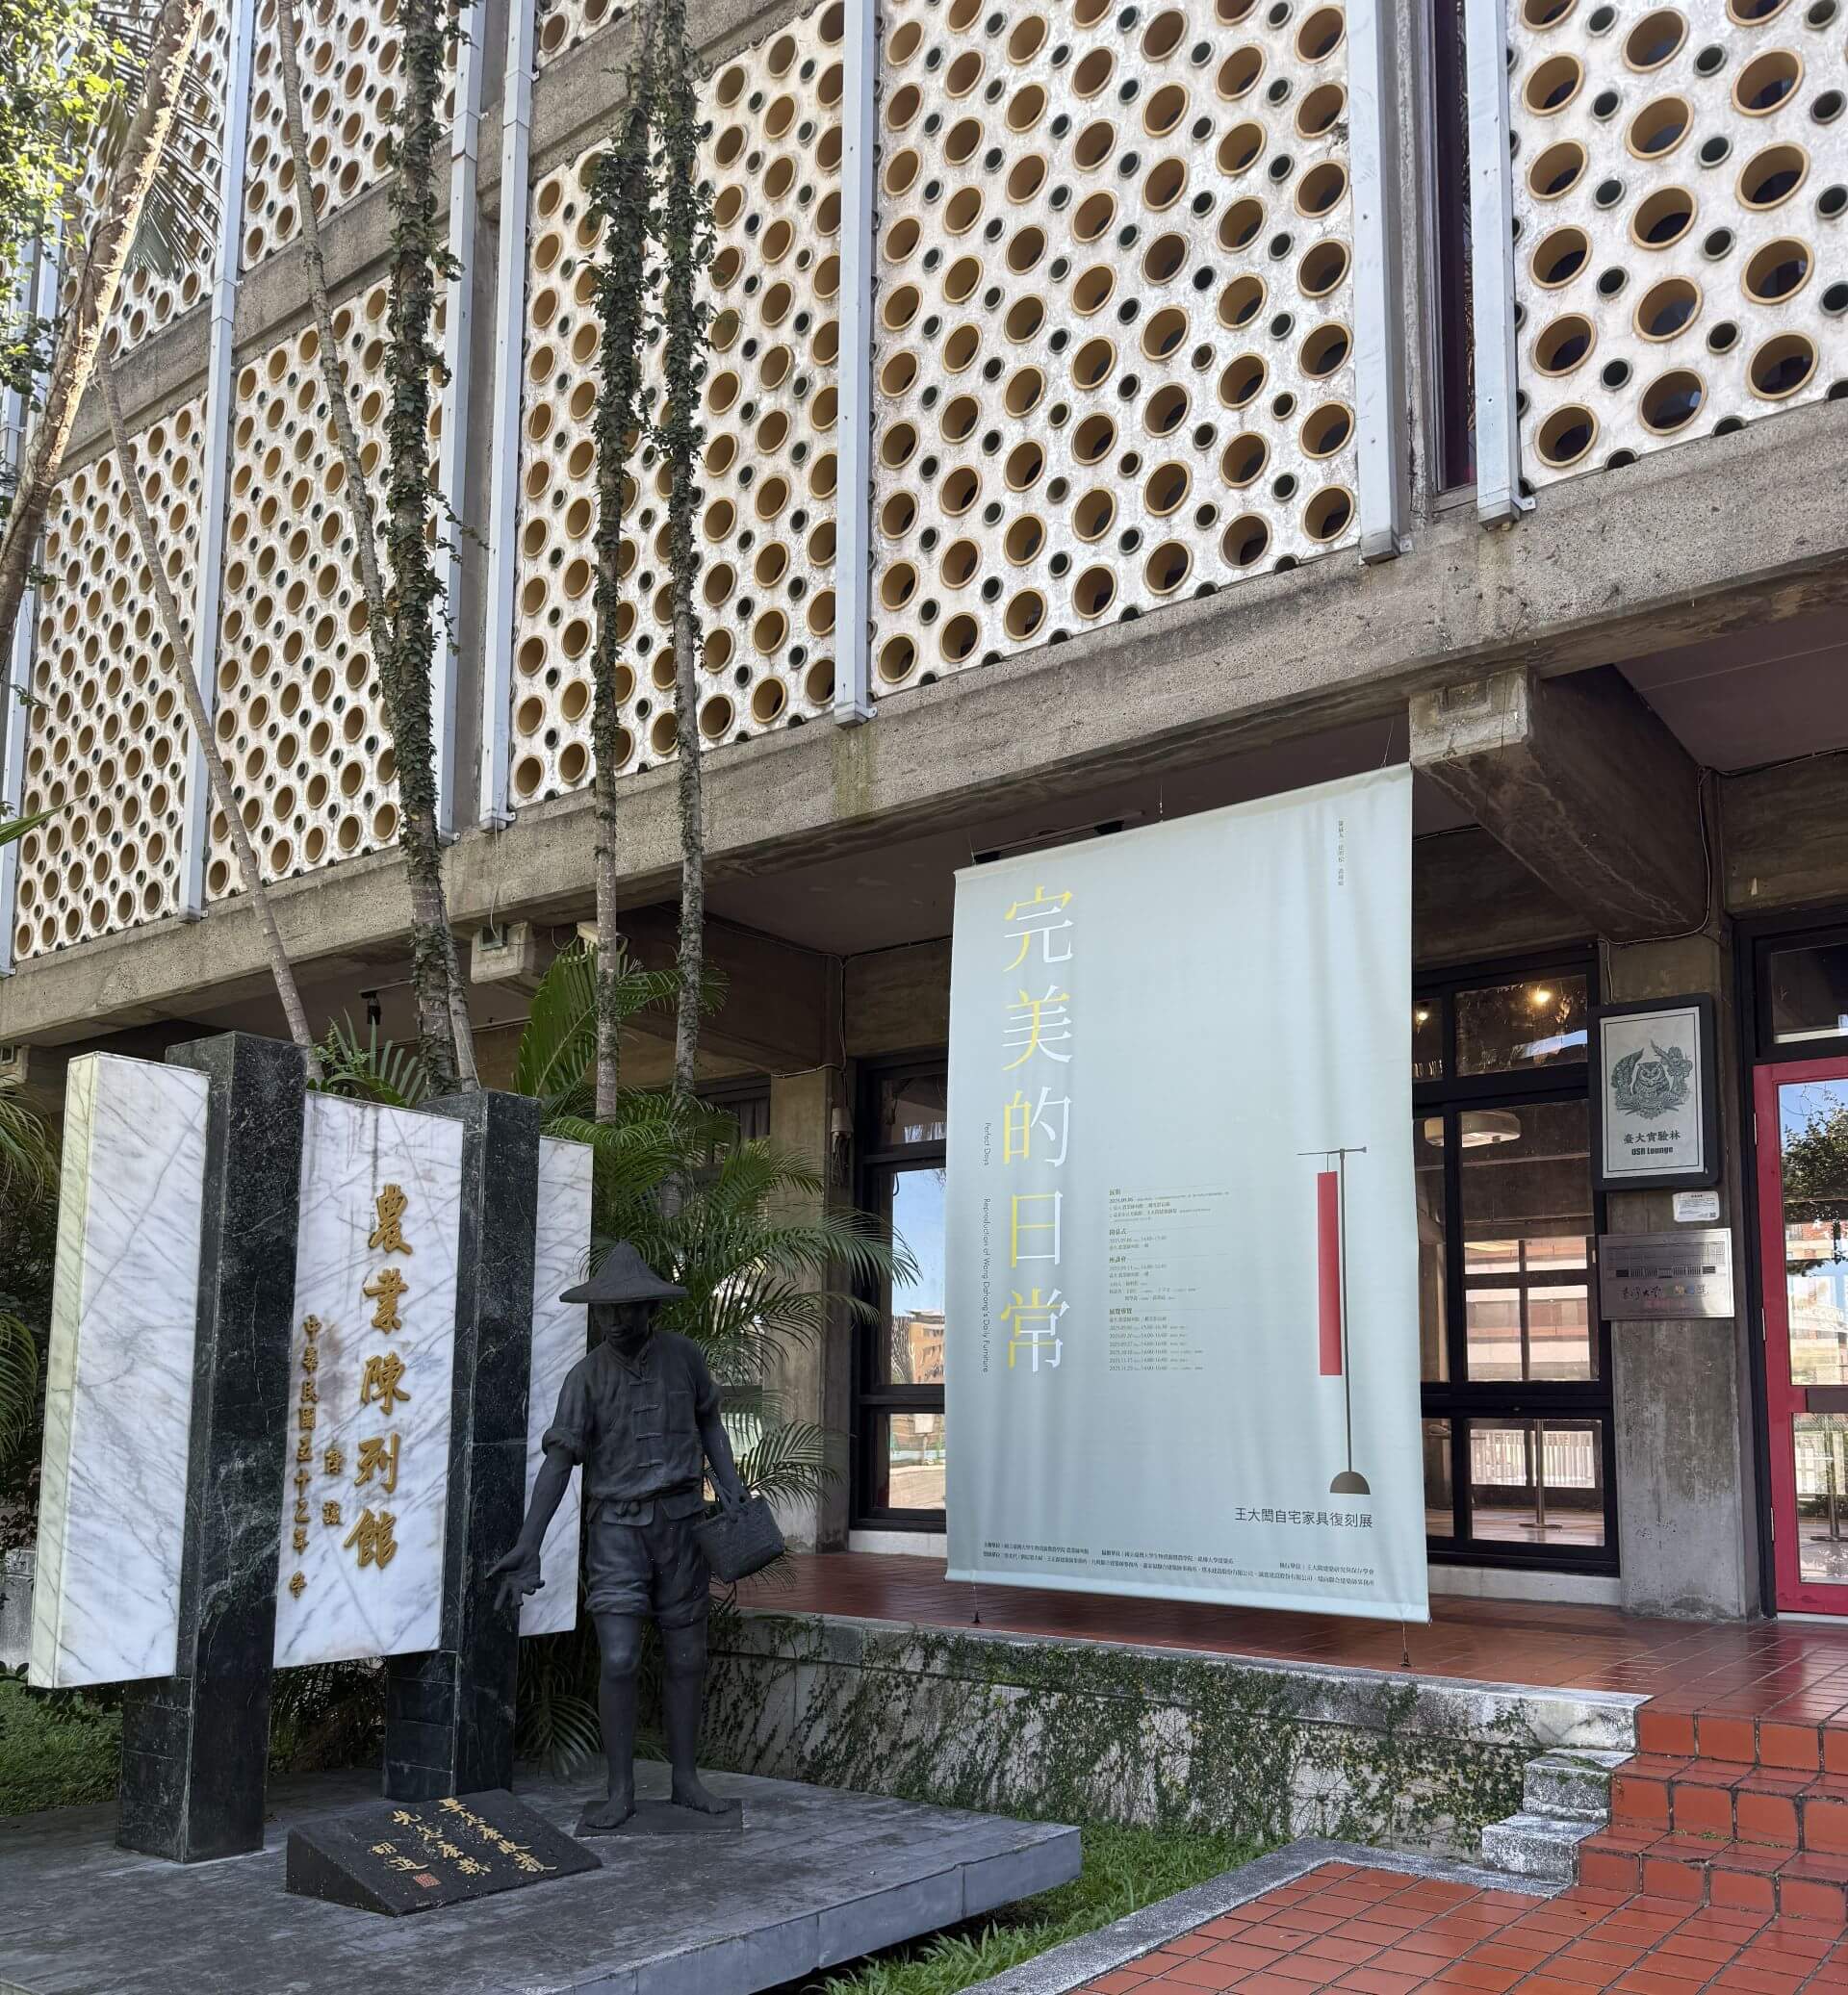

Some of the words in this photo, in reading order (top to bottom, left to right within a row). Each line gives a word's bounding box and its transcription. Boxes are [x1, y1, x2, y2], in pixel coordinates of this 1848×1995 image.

[1001, 885, 1074, 1373] 完美的日常
[1624, 1130, 1681, 1144] 臺大實驗林
[983, 1148, 991, 1166] Days
[983, 1197, 991, 1246] Reproduction
[982, 1258, 990, 1279] Wang
[982, 1319, 990, 1339] Daily
[344, 1184, 414, 1571] 農業陳列館
[1235, 1507, 1373, 1528] 王大閎自宅家具復刻展
